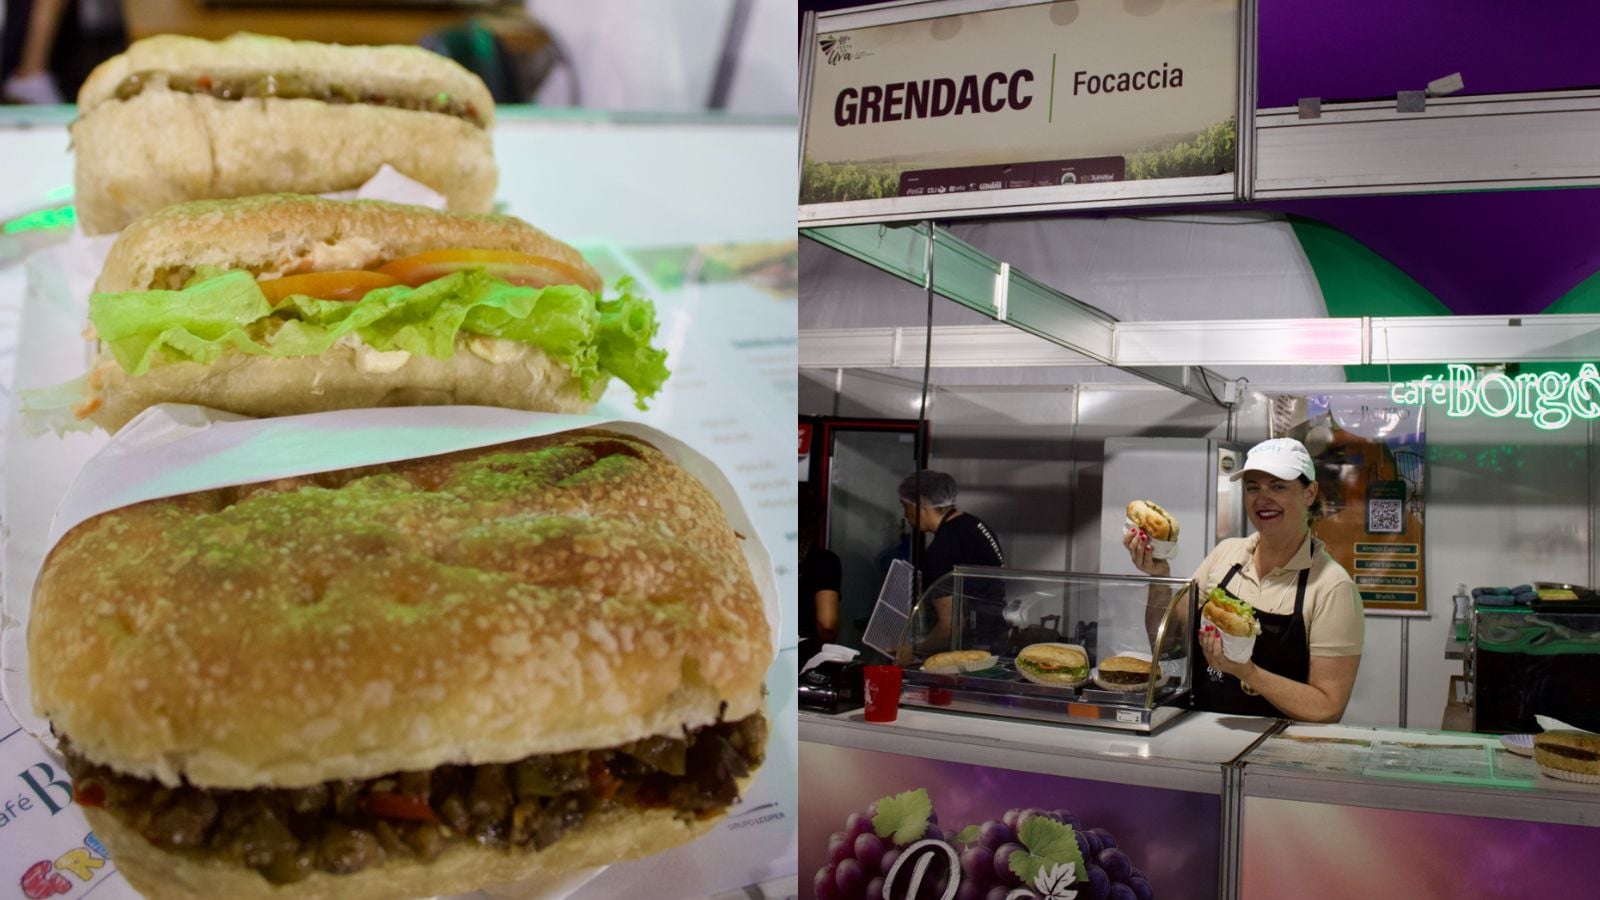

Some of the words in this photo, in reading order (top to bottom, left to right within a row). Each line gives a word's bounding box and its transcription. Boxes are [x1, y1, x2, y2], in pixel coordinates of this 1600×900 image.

[1073, 62, 1184, 96] Focaccia
[834, 69, 1034, 127] GRENDACC
[1391, 374, 1447, 405] café
